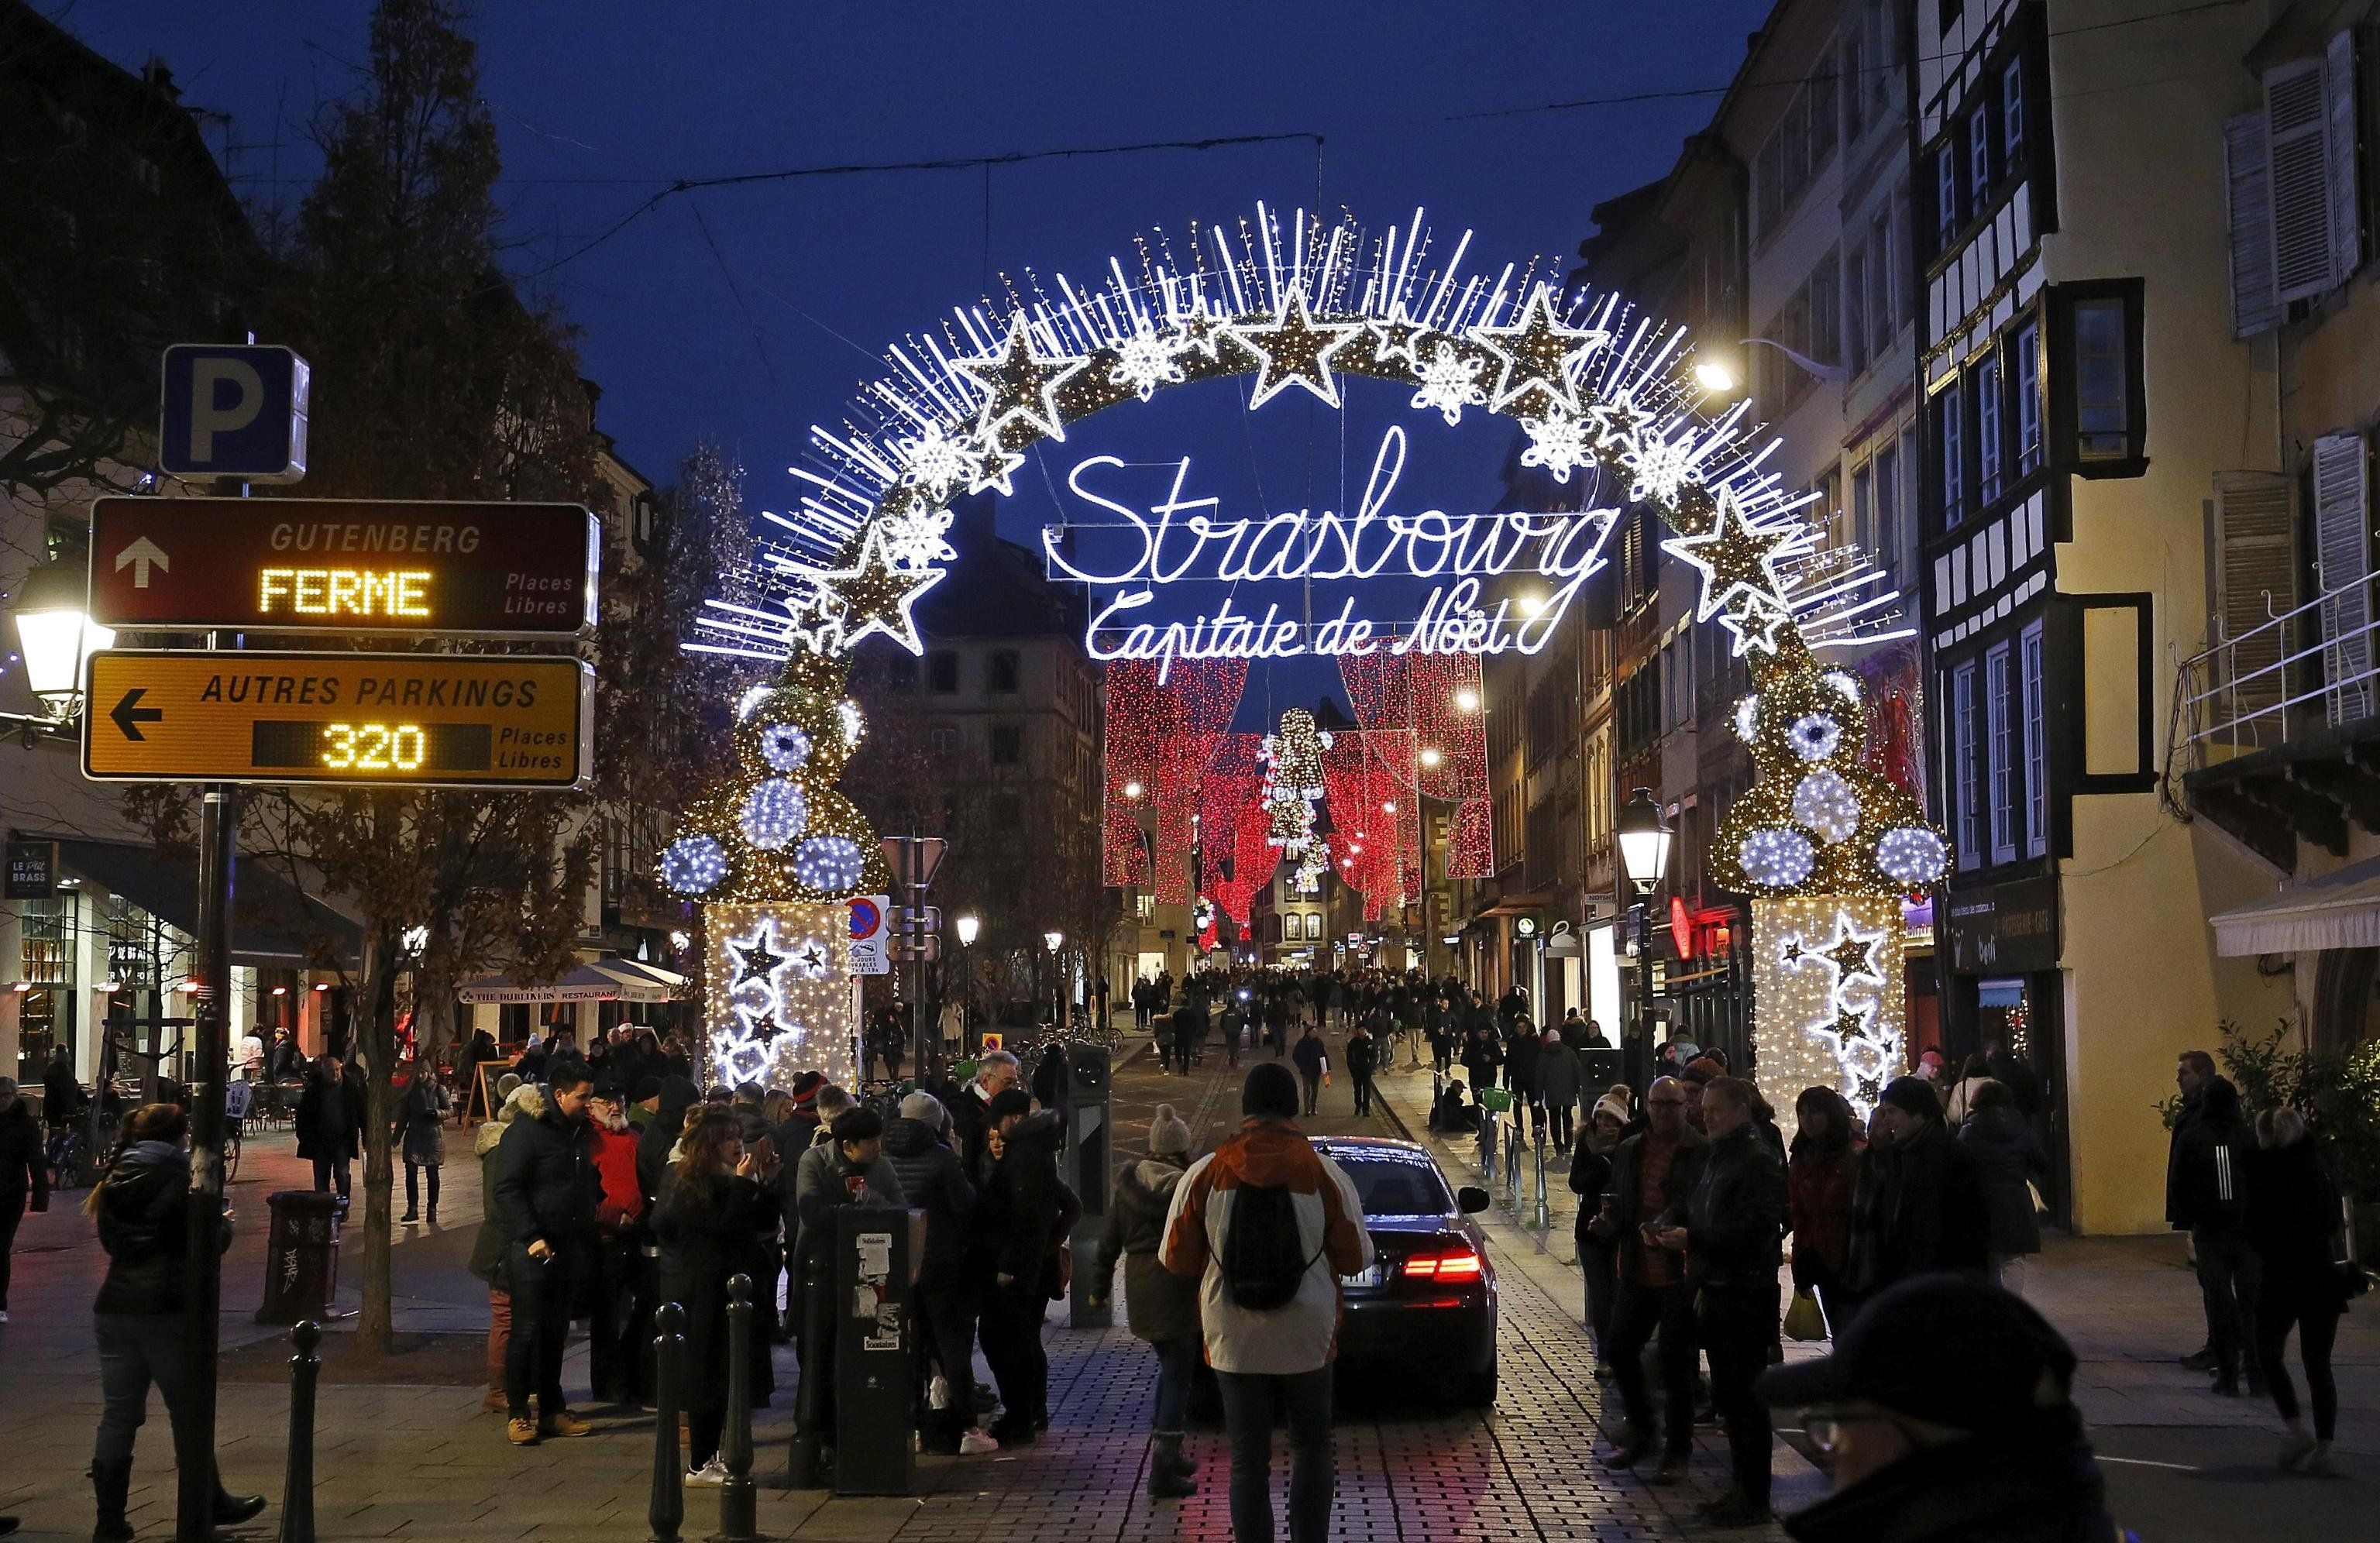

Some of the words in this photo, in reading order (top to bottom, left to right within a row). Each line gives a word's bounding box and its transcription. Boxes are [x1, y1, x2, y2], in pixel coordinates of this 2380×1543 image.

[190, 358, 264, 462] P
[271, 524, 480, 553] GUTENBERG
[1042, 424, 1622, 657] Strasbourg
[260, 568, 432, 617] FERME
[505, 573, 573, 593] Places
[504, 596, 567, 615] Libres
[1085, 589, 1306, 686] Capitale
[1316, 596, 1377, 656] de
[1394, 578, 1510, 656] Noël
[201, 675, 341, 705] AUTRES
[356, 679, 537, 708] PARKINGS
[322, 724, 425, 769] 320
[499, 728, 567, 747] Places
[498, 751, 562, 769] Libres
[12, 873, 46, 881] BRASS
[13, 862, 23, 871] LE
[476, 993, 496, 1002] THE
